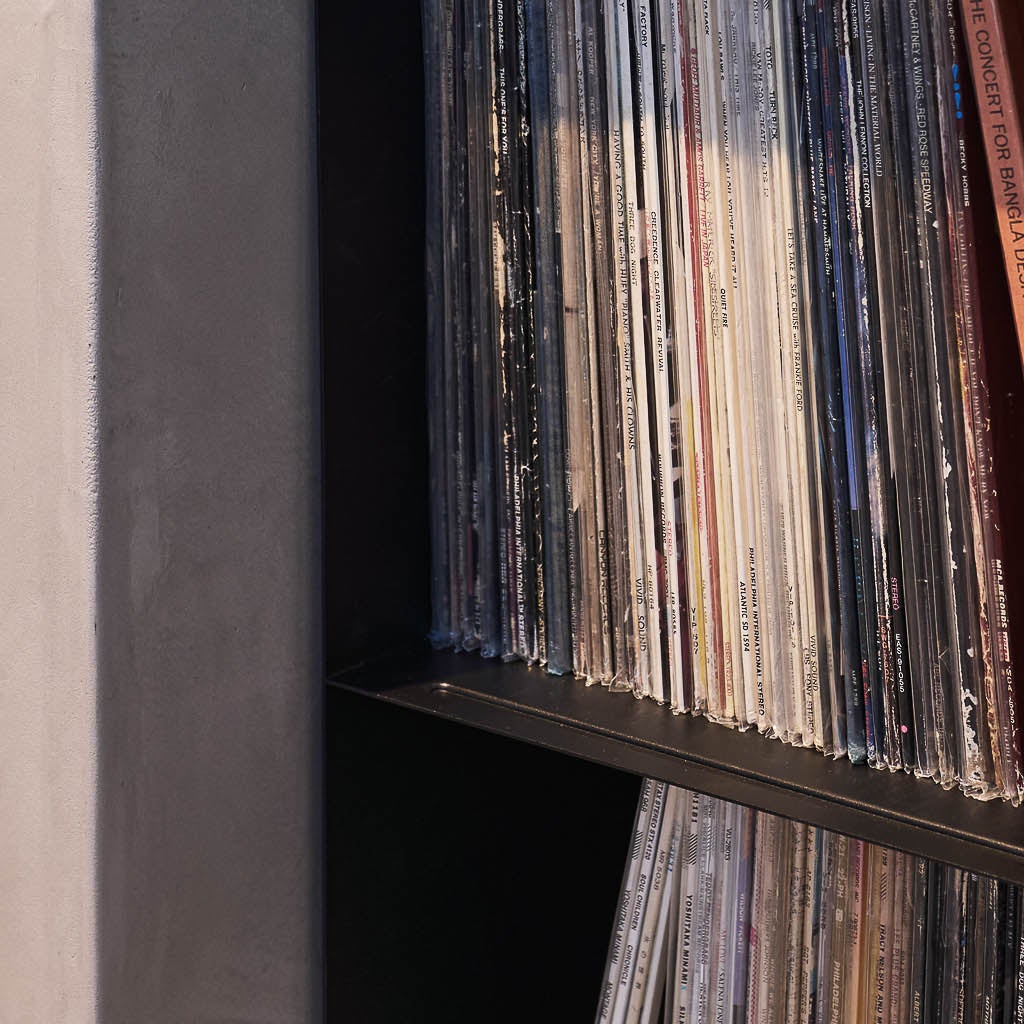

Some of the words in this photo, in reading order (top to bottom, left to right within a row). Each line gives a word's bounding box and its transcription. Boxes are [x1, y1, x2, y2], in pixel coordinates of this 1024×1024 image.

[640, 5, 648, 48] FACTORY
[588, 40, 596, 75] KOOPER
[865, 31, 874, 61] LIVING
[868, 63, 875, 73] IN
[868, 75, 877, 93] THE
[913, 66, 924, 100] WINGS
[769, 90, 777, 115] TURN
[856, 79, 864, 95] THE
[976, 29, 1003, 118] CONCERT
[992, 124, 1013, 161] FOR
[590, 96, 598, 115] NEW
[693, 85, 702, 127] MULDAUR
[857, 97, 865, 119] JOHN
[870, 95, 880, 142] MATERIAL
[916, 108, 926, 128] RED
[591, 119, 599, 141] YORK
[858, 121, 867, 154] LENNON
[918, 130, 928, 157] ROSE
[592, 143, 600, 165] CITY
[613, 129, 623, 170] HAVING
[695, 136, 704, 163] AMOS
[816, 137, 826, 187] WHITESNAKE
[873, 144, 883, 178] WORLD
[959, 139, 967, 171] BECKY
[697, 164, 706, 202] GARRETT
[860, 156, 871, 209] COLLECTION
[920, 158, 932, 214] SPEEDWAY
[616, 184, 625, 218] GOOD
[628, 201, 636, 230] THREE
[821, 208, 828, 218] AT
[618, 221, 627, 244] TIME
[699, 209, 707, 228] LIVE
[700, 229, 708, 239] IN
[650, 211, 659, 265] CREEDENCE
[822, 220, 832, 276] HAMMERSMITH
[619, 246, 628, 265] with
[701, 241, 710, 268] JAPAN
[789, 252, 797, 272] TAKE
[620, 268, 629, 295] HUEY
[631, 259, 639, 287] NIGHT
[654, 270, 663, 332] CLEARWATER
[790, 283, 798, 300] SEA
[791, 302, 800, 331] CRUISE
[624, 341, 633, 372] SMITH
[657, 337, 665, 374] REVIVAL
[794, 352, 802, 386] FRANKIE
[626, 386, 634, 402] HIS
[795, 389, 804, 412] FORD
[627, 405, 637, 451] CLOWNS
[516, 536, 524, 603] INTERNATIONAL
[749, 547, 758, 608] PHILADELPHIA
[635, 577, 644, 605] VIVID
[740, 582, 748, 618] ATLANTIC
[891, 577, 899, 611] STEREO
[518, 613, 526, 649] STEREO
[637, 614, 647, 651] SOUND
[742, 621, 749, 632] SD
[753, 611, 762, 677] INTERNATIONAL
[811, 659, 819, 692] SOUND
[757, 681, 765, 716] STEREO
[807, 700, 815, 735] STEREO
[650, 800, 662, 829] STEREO
[645, 844, 653, 861] 4120
[647, 829, 657, 844] STX
[637, 874, 648, 893] SOUL
[705, 872, 713, 901] TEDDY
[617, 889, 632, 933] YOSHITAKA
[631, 894, 644, 931] CHILDREN
[683, 894, 693, 948] YOSHITAKA
[611, 933, 624, 965] MINAMI
[621, 944, 635, 987] CHRONICLE
[681, 948, 690, 985] MINAMI
[601, 981, 614, 1020] MONTAGE
[718, 971, 727, 1002] SALENA
